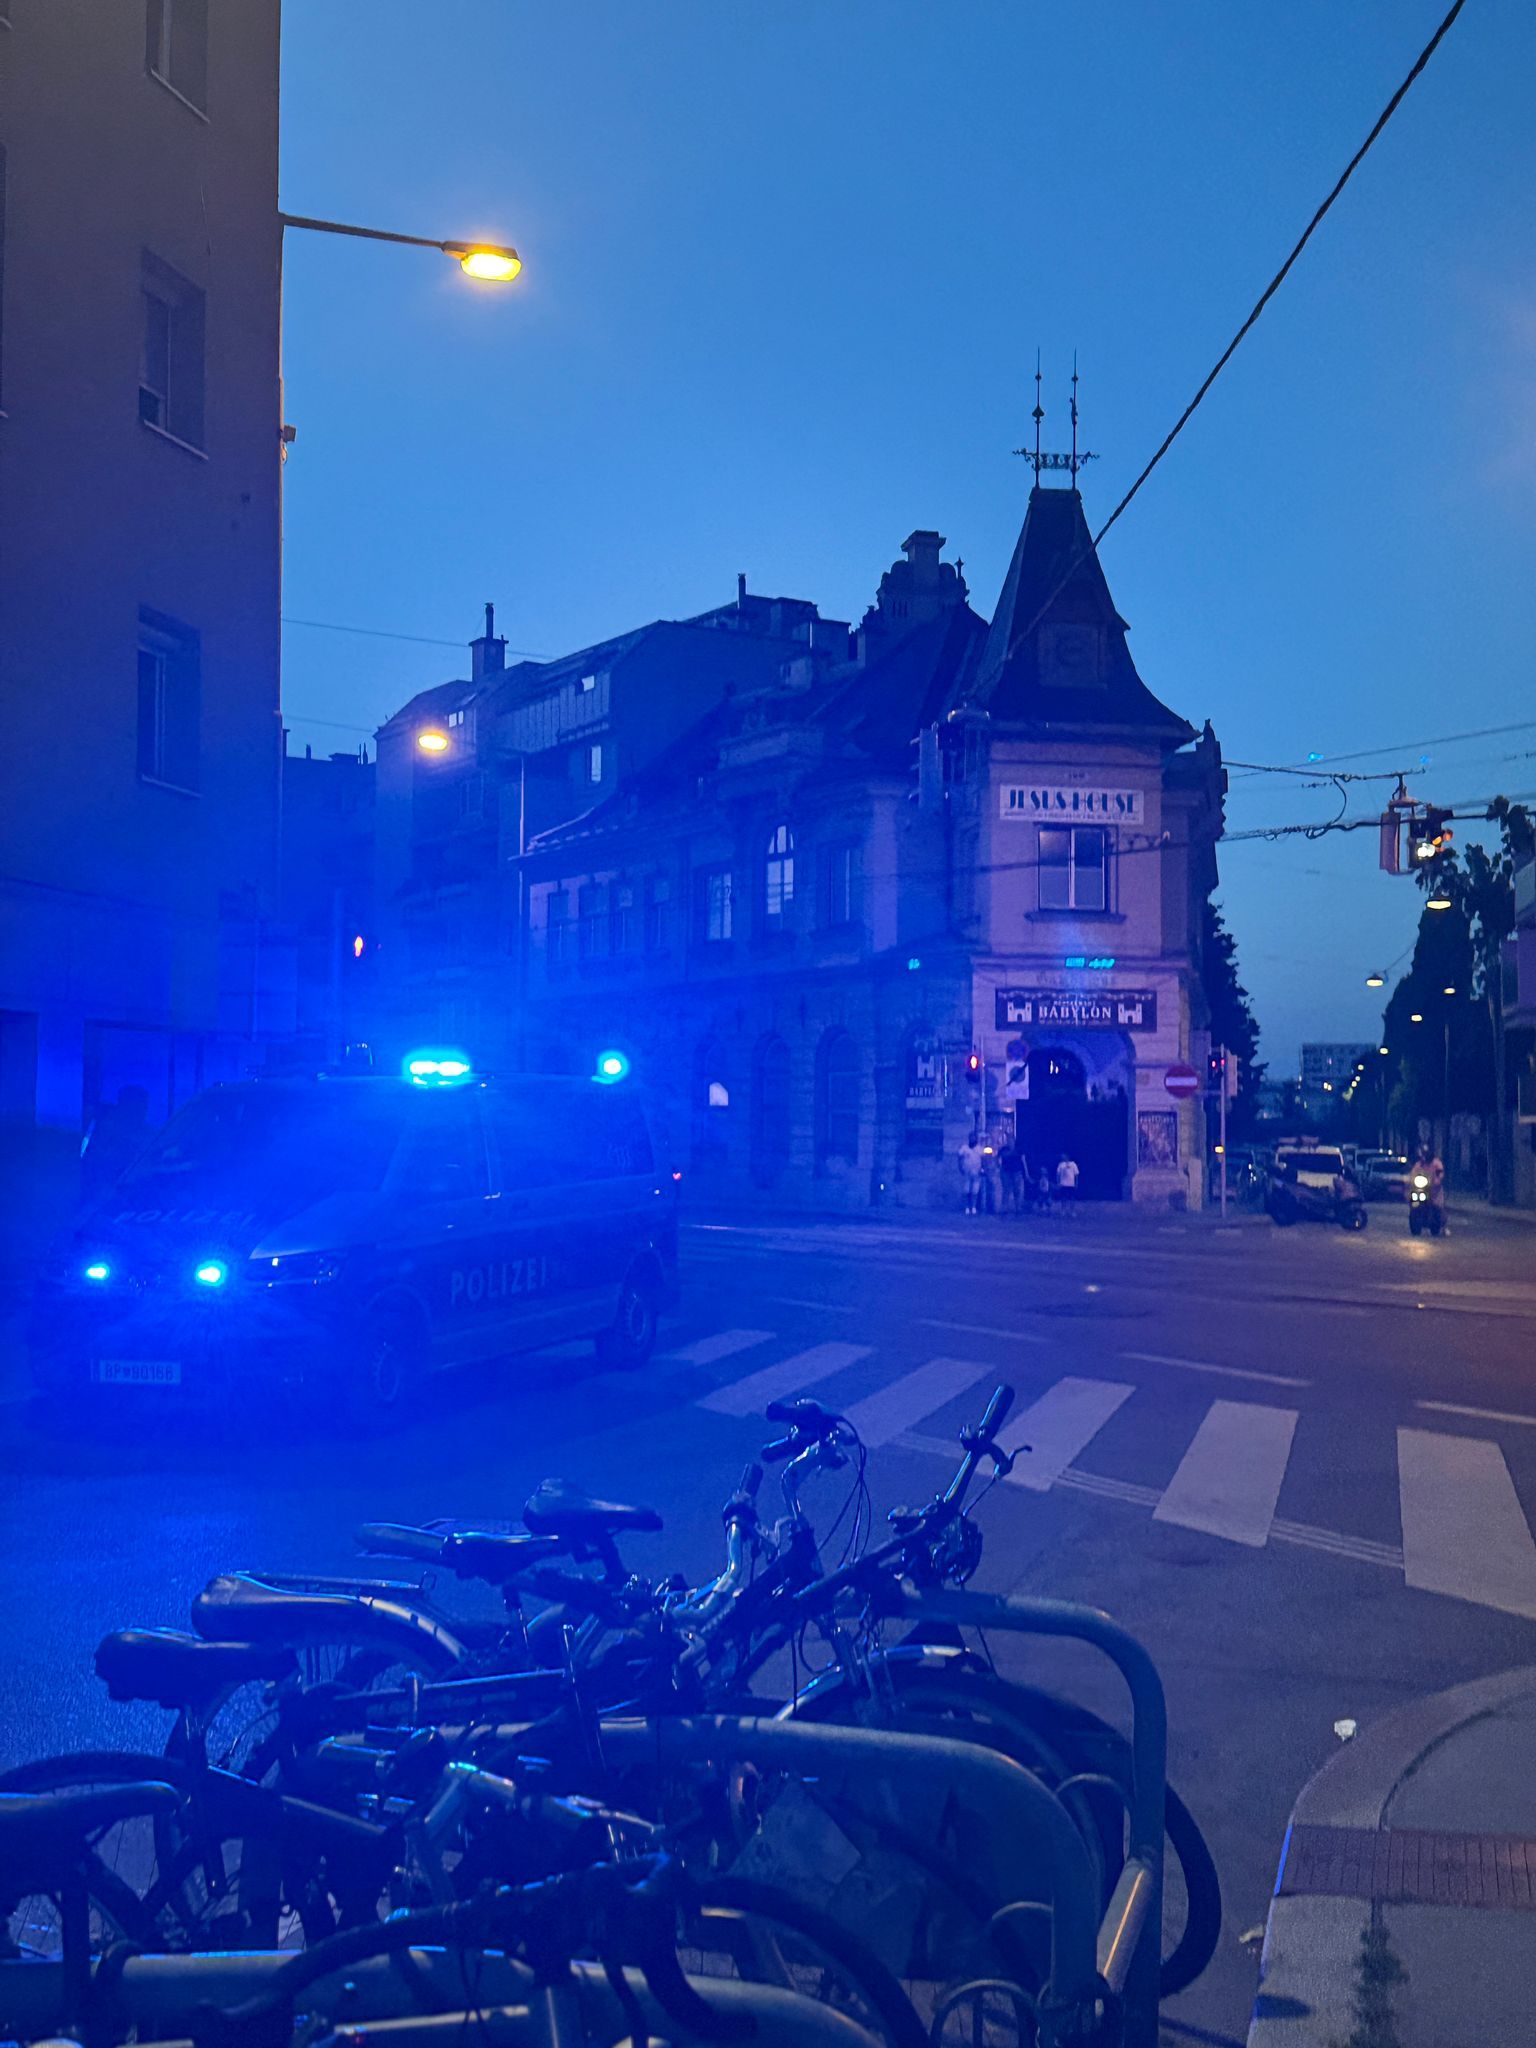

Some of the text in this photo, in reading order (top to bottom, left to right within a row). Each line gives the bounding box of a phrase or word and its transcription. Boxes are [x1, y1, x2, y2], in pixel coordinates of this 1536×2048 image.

[1009, 789, 1136, 813] JESUS HOUSE
[1039, 1006, 1111, 1019] BABYLON
[112, 1209, 257, 1230] POLIZEI
[450, 1256, 547, 1311] POLIZEI
